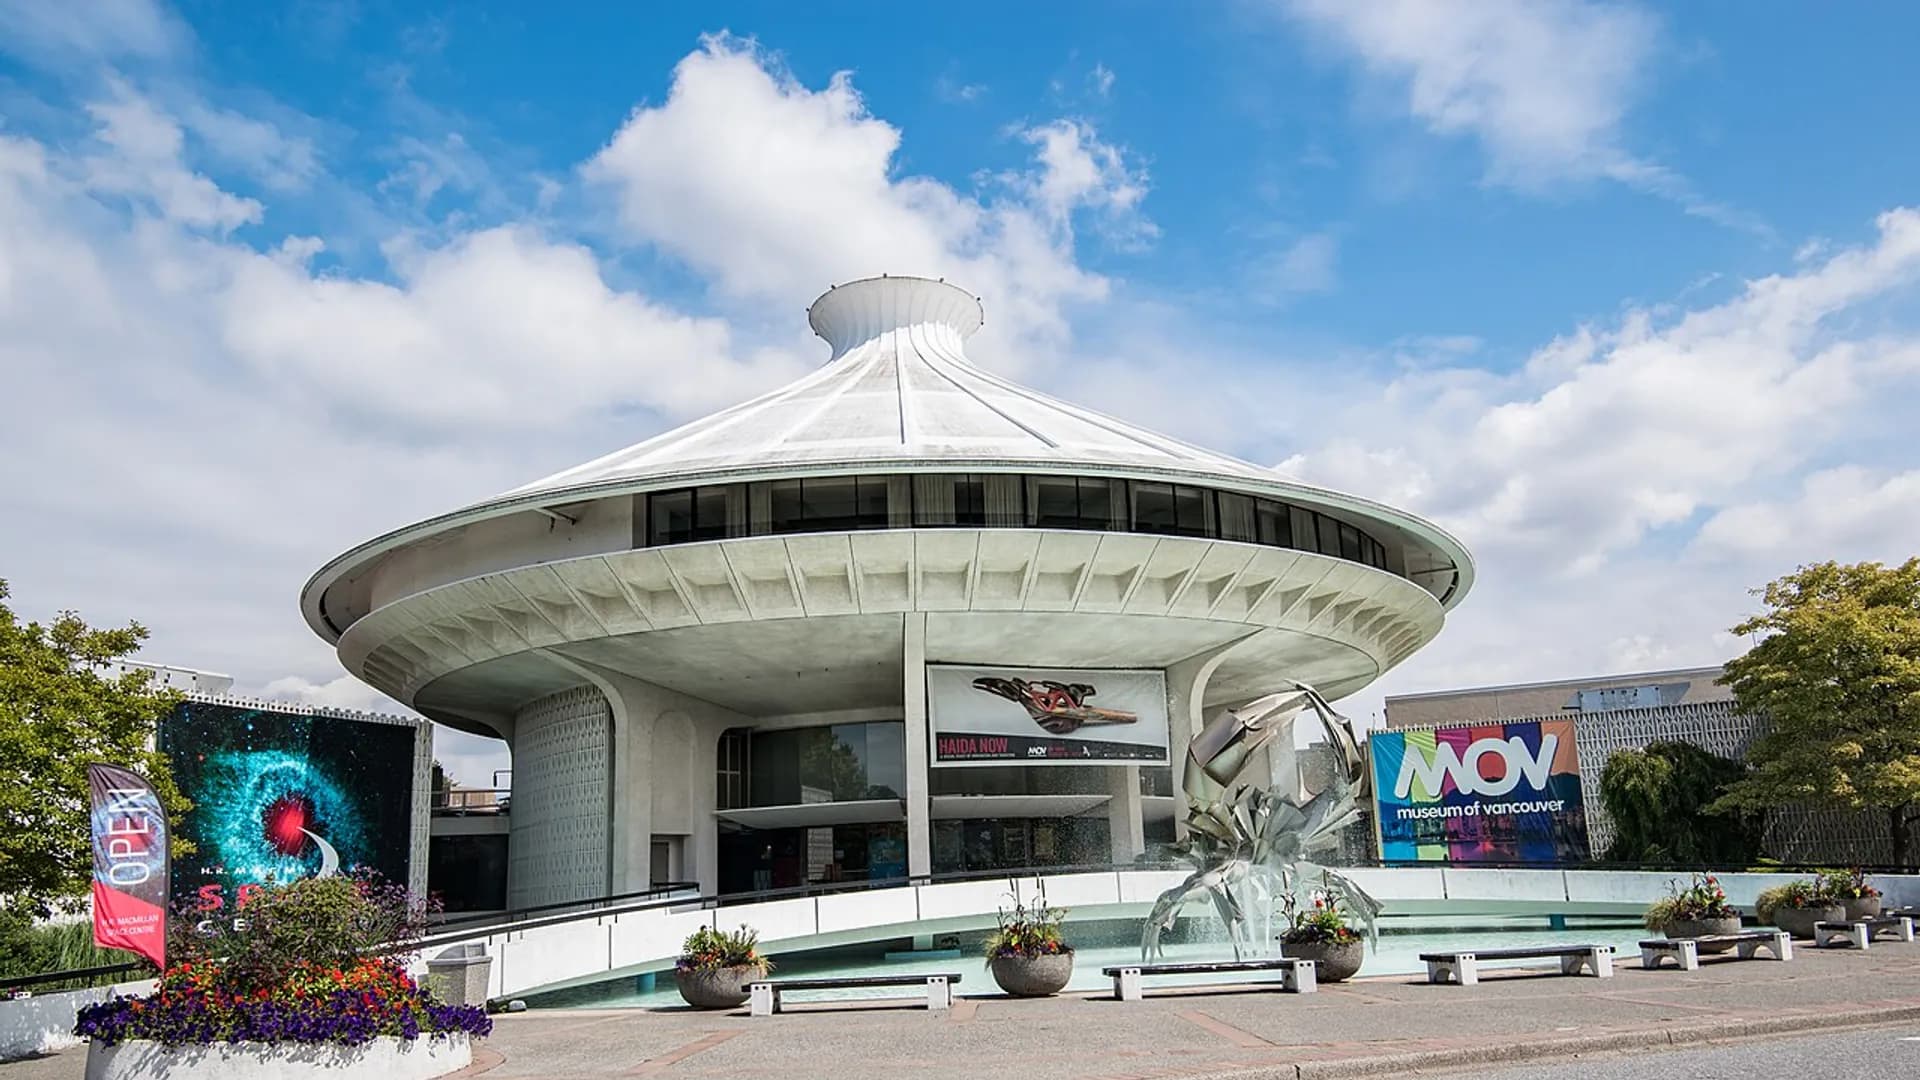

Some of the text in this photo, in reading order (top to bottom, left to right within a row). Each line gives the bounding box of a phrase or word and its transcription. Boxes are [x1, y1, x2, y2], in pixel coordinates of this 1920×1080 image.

[938, 737, 1008, 754] HAIDA NOW
[1394, 733, 1558, 799] MOV
[1397, 799, 1565, 819] museum of vancouver
[107, 788, 150, 886] OPEN
